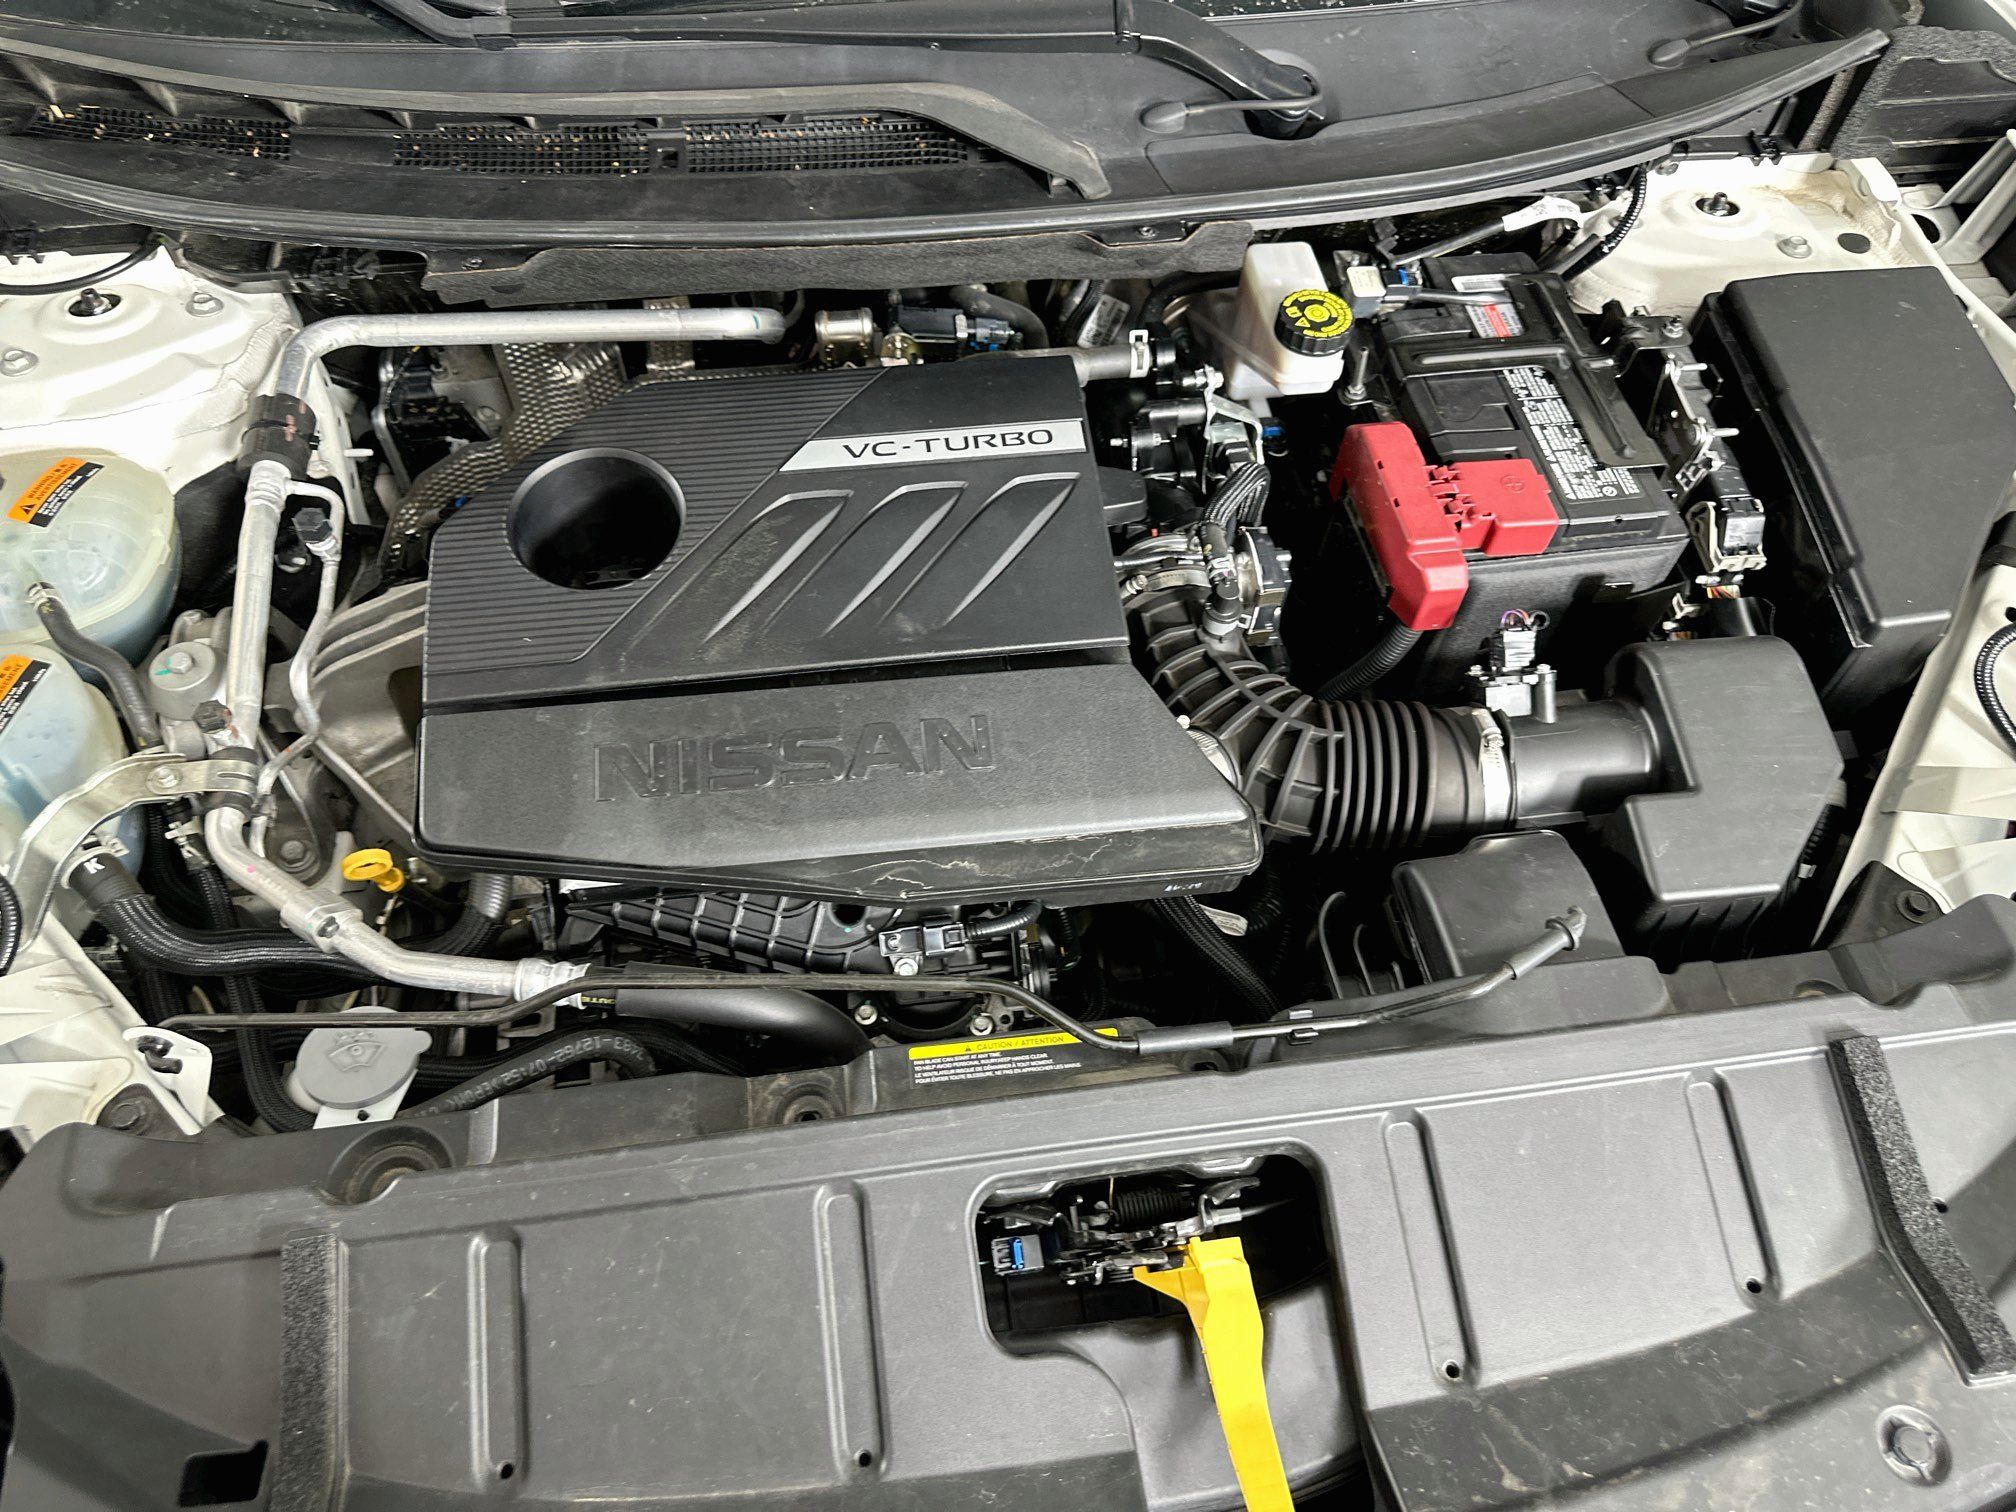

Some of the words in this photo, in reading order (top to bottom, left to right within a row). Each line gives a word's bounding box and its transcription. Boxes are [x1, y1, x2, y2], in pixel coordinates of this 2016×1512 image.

[842, 429, 1054, 459] VC-TURBO
[593, 714, 999, 803] NISSAN
[84, 857, 106, 874] K
[975, 1040, 1012, 1051] CAUTION
[1020, 1035, 1064, 1046] ATTENTION
